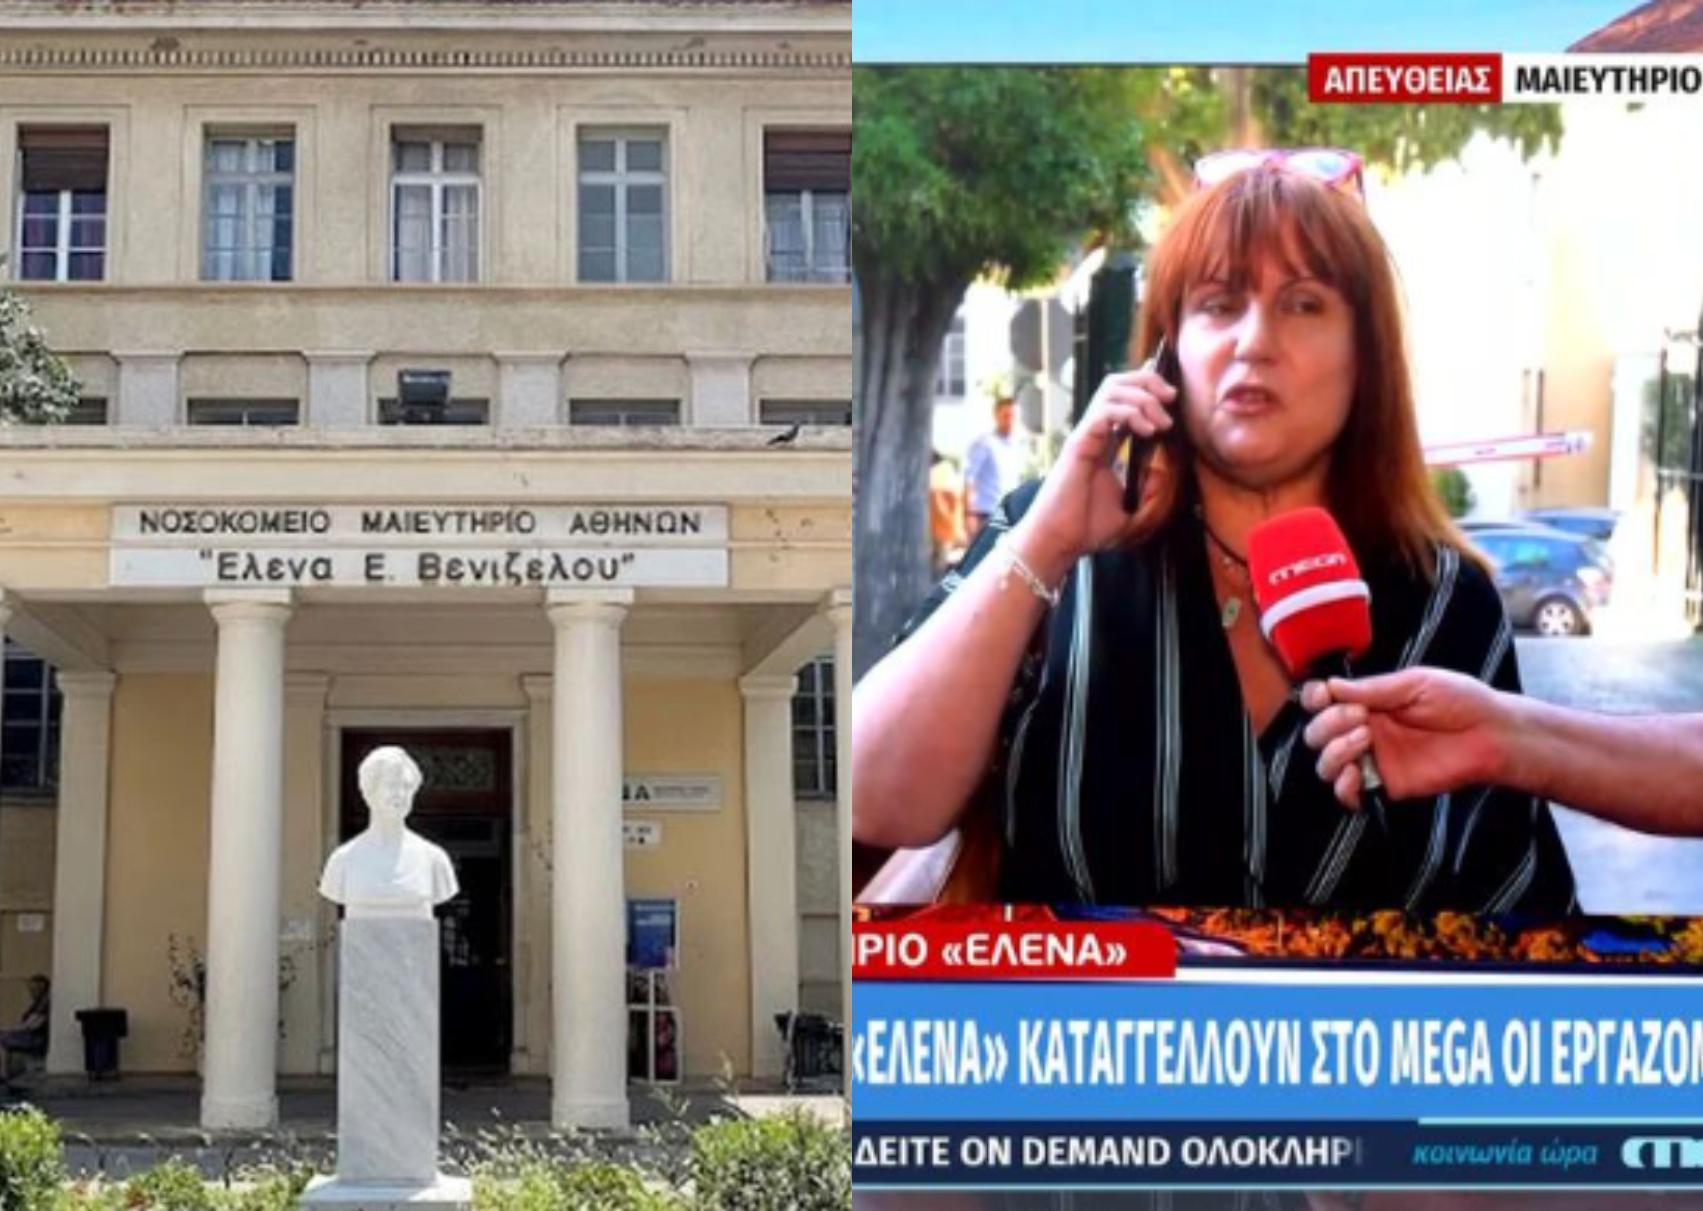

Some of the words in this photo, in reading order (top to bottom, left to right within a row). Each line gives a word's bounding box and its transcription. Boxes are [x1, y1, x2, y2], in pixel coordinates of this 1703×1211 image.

[139, 509, 331, 534] ΝΟΣΟΚΟΜΕΙΟ
[361, 510, 536, 534] ΜΑΙΕΥΤΗΡΙΟ
[569, 510, 701, 535] ΑΘΗΝΩΝ
